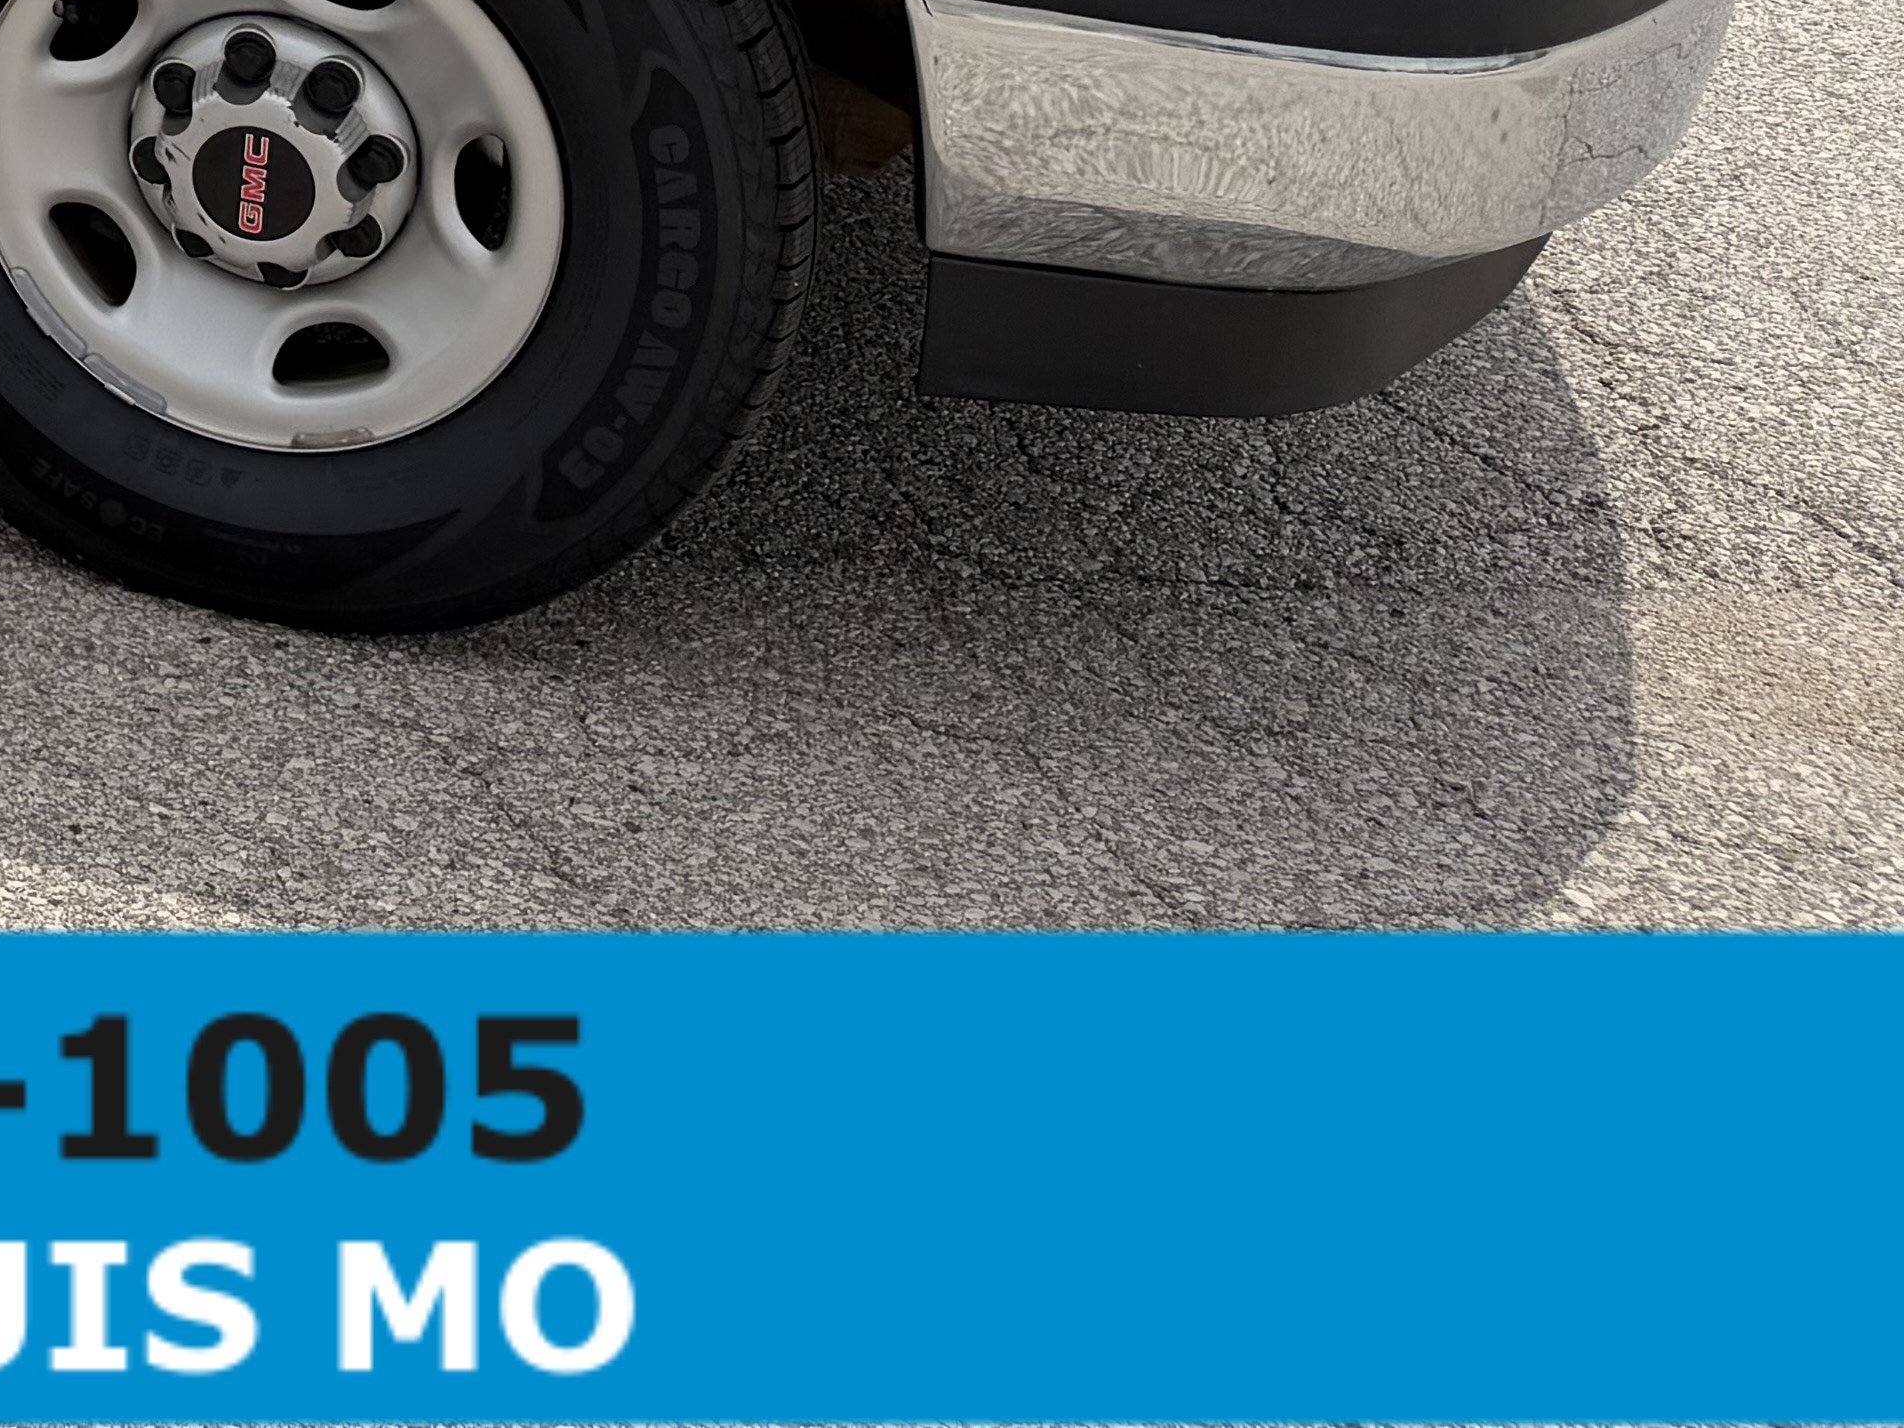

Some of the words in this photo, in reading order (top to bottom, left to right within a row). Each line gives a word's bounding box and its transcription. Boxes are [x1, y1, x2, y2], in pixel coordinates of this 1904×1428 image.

[237, 131, 271, 235] GMC
[648, 123, 701, 329] CARGO
[557, 328, 681, 490] AW-03
